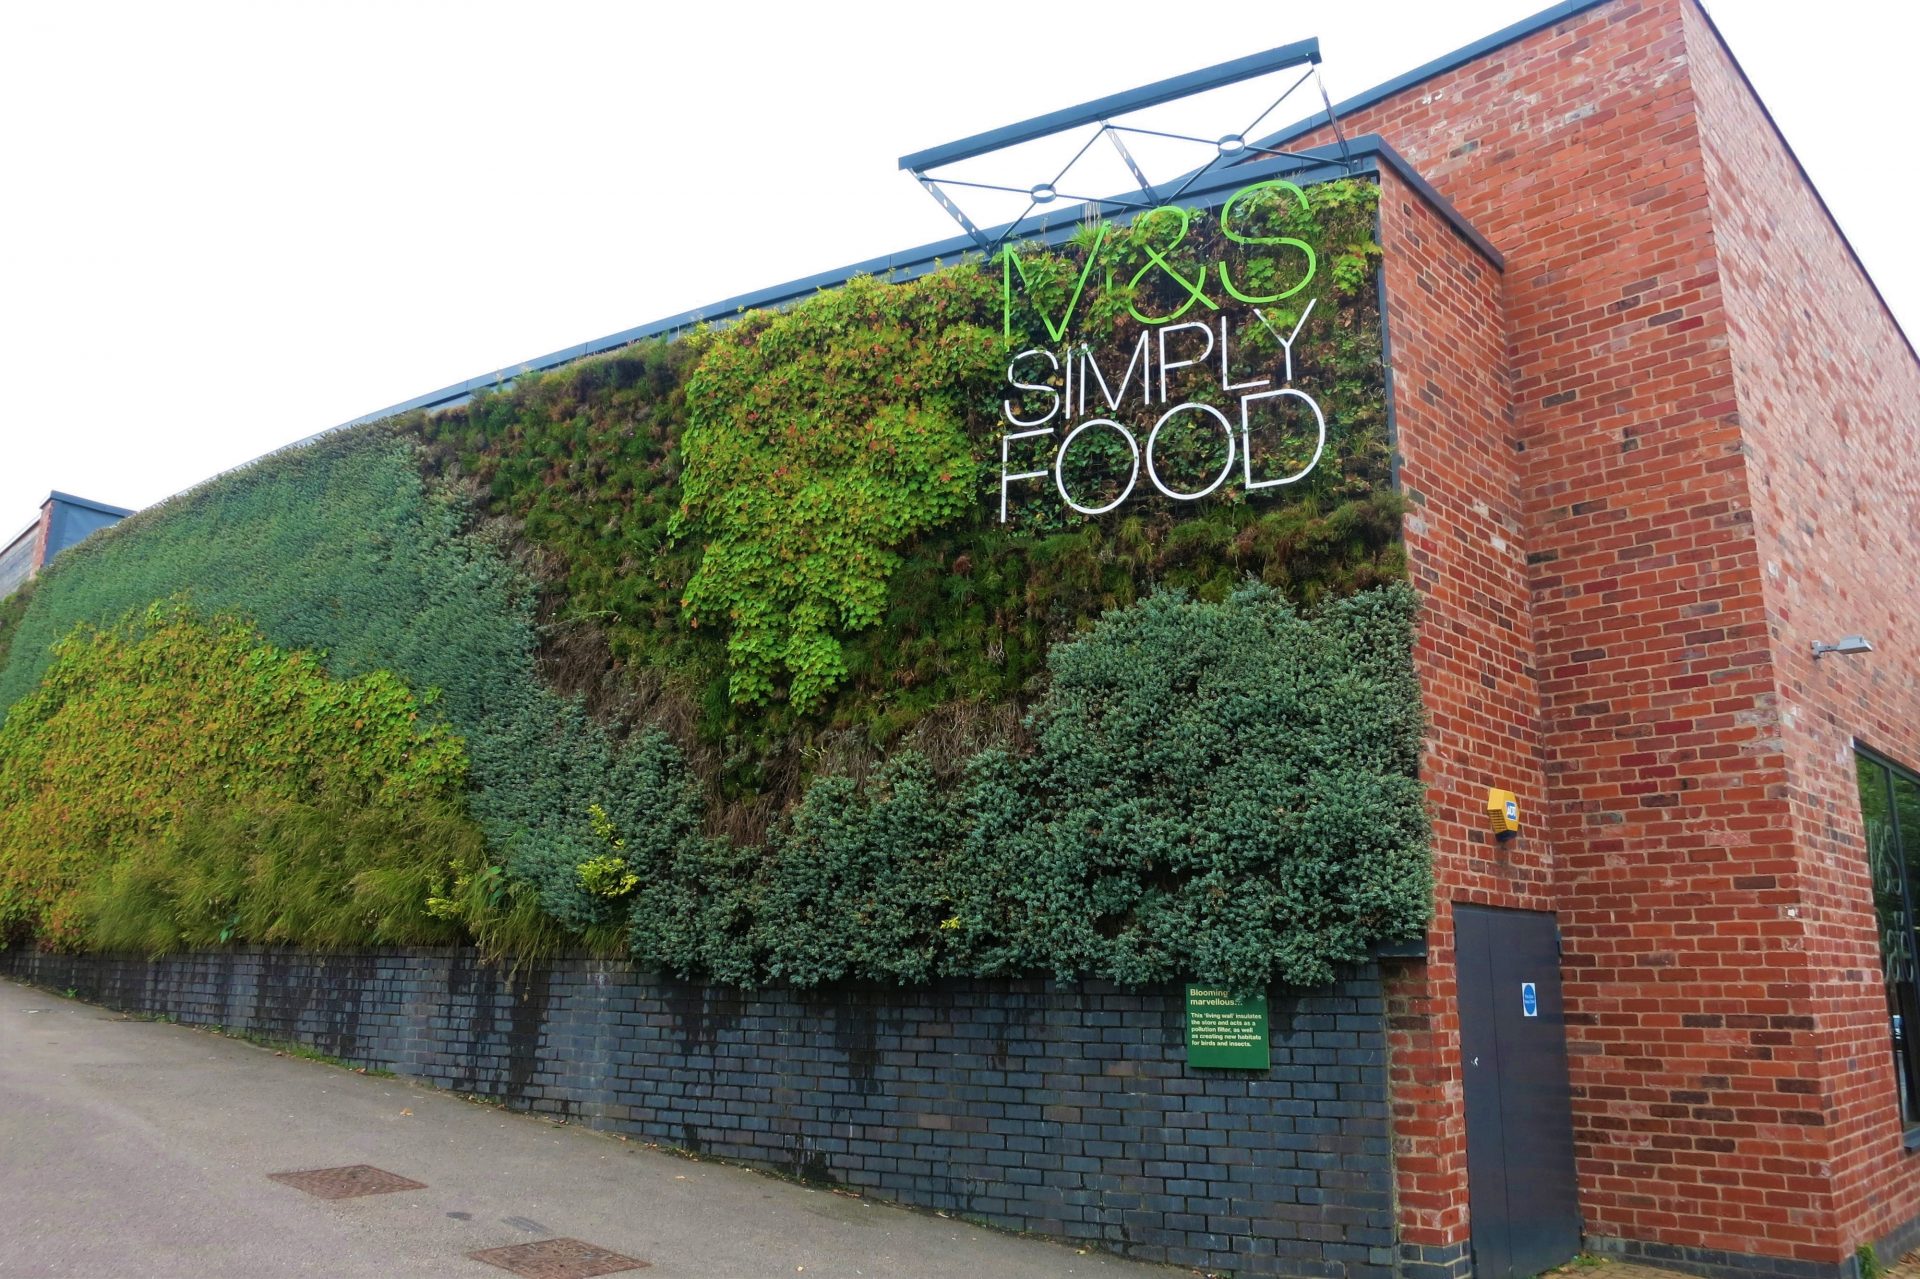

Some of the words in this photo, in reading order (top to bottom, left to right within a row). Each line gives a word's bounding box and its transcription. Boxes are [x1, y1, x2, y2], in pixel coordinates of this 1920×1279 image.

[1003, 180, 1317, 352] M&S
[1004, 298, 1318, 428] SIMPLY
[999, 388, 1326, 523] FOOD
[1190, 988, 1228, 998] Blooming
